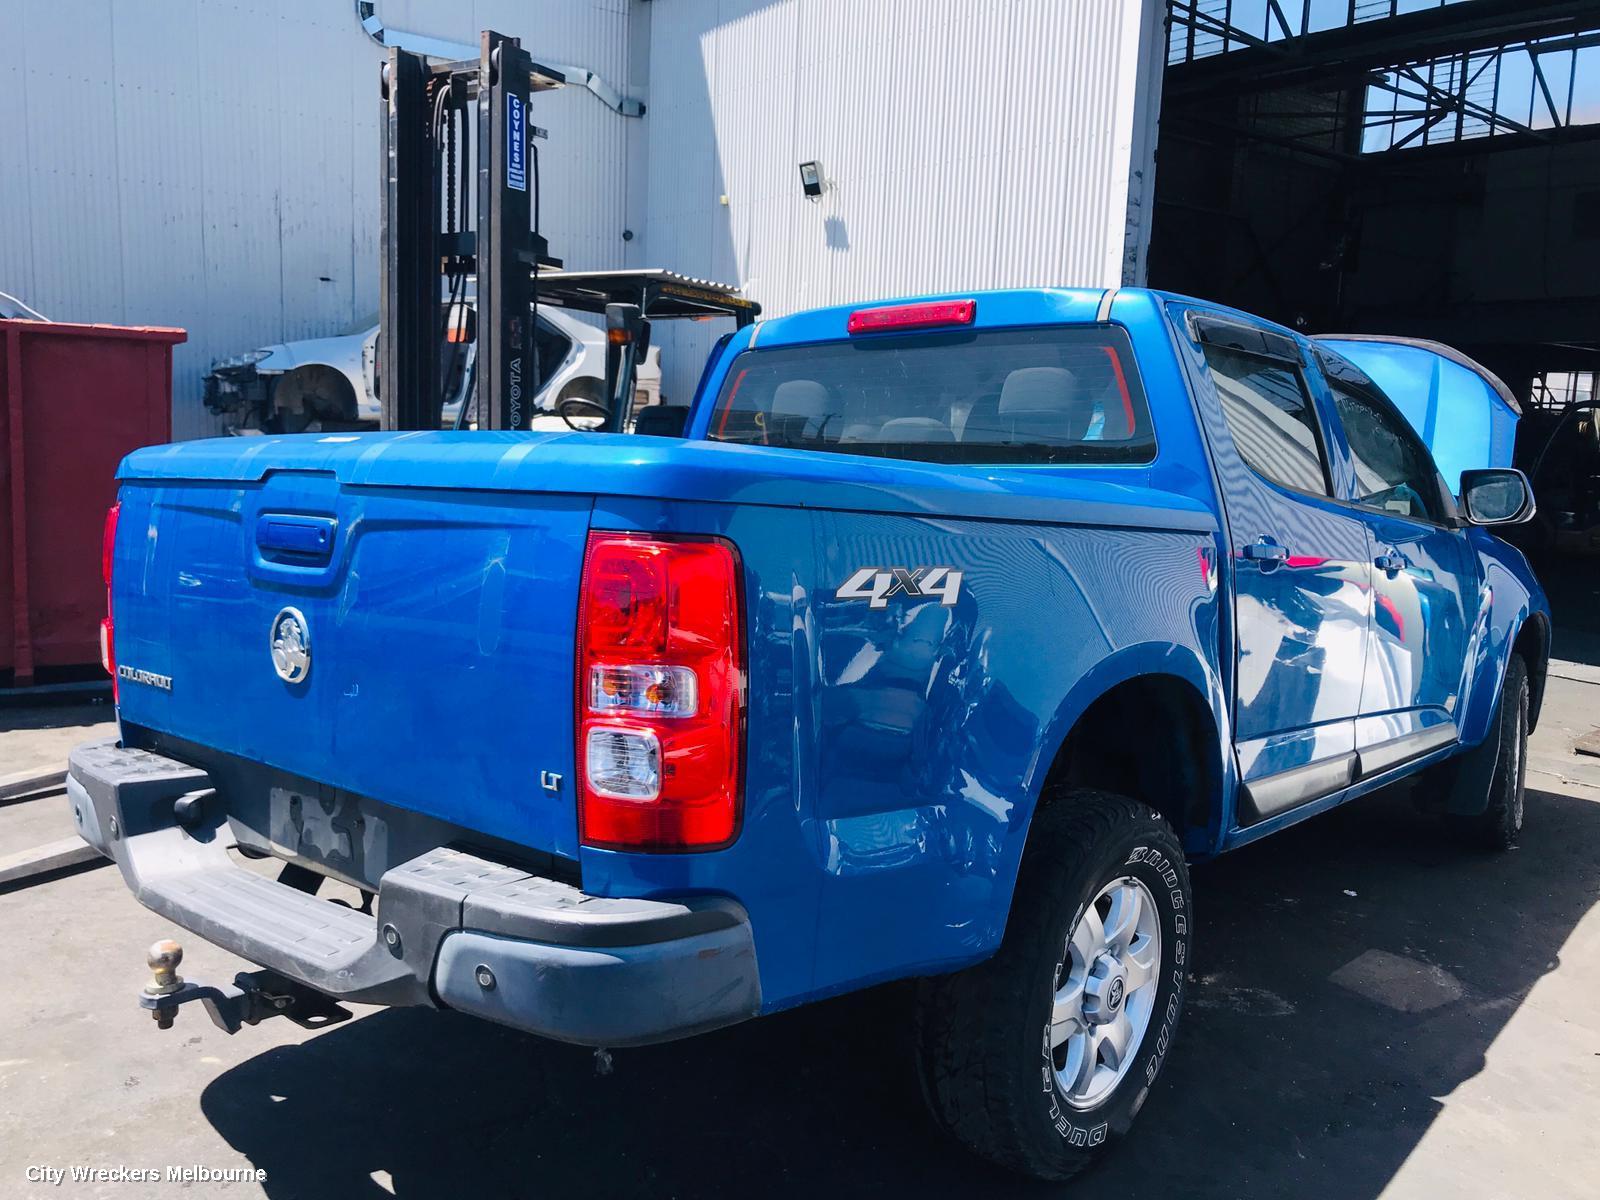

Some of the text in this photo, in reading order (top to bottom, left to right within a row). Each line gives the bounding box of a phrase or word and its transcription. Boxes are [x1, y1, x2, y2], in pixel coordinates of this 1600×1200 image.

[512, 98, 521, 163] COYNES
[510, 357, 521, 430] OYOTA
[118, 664, 172, 690] COLORADO
[541, 770, 562, 791] LT
[1124, 846, 1187, 1086] BRIDGESTONE
